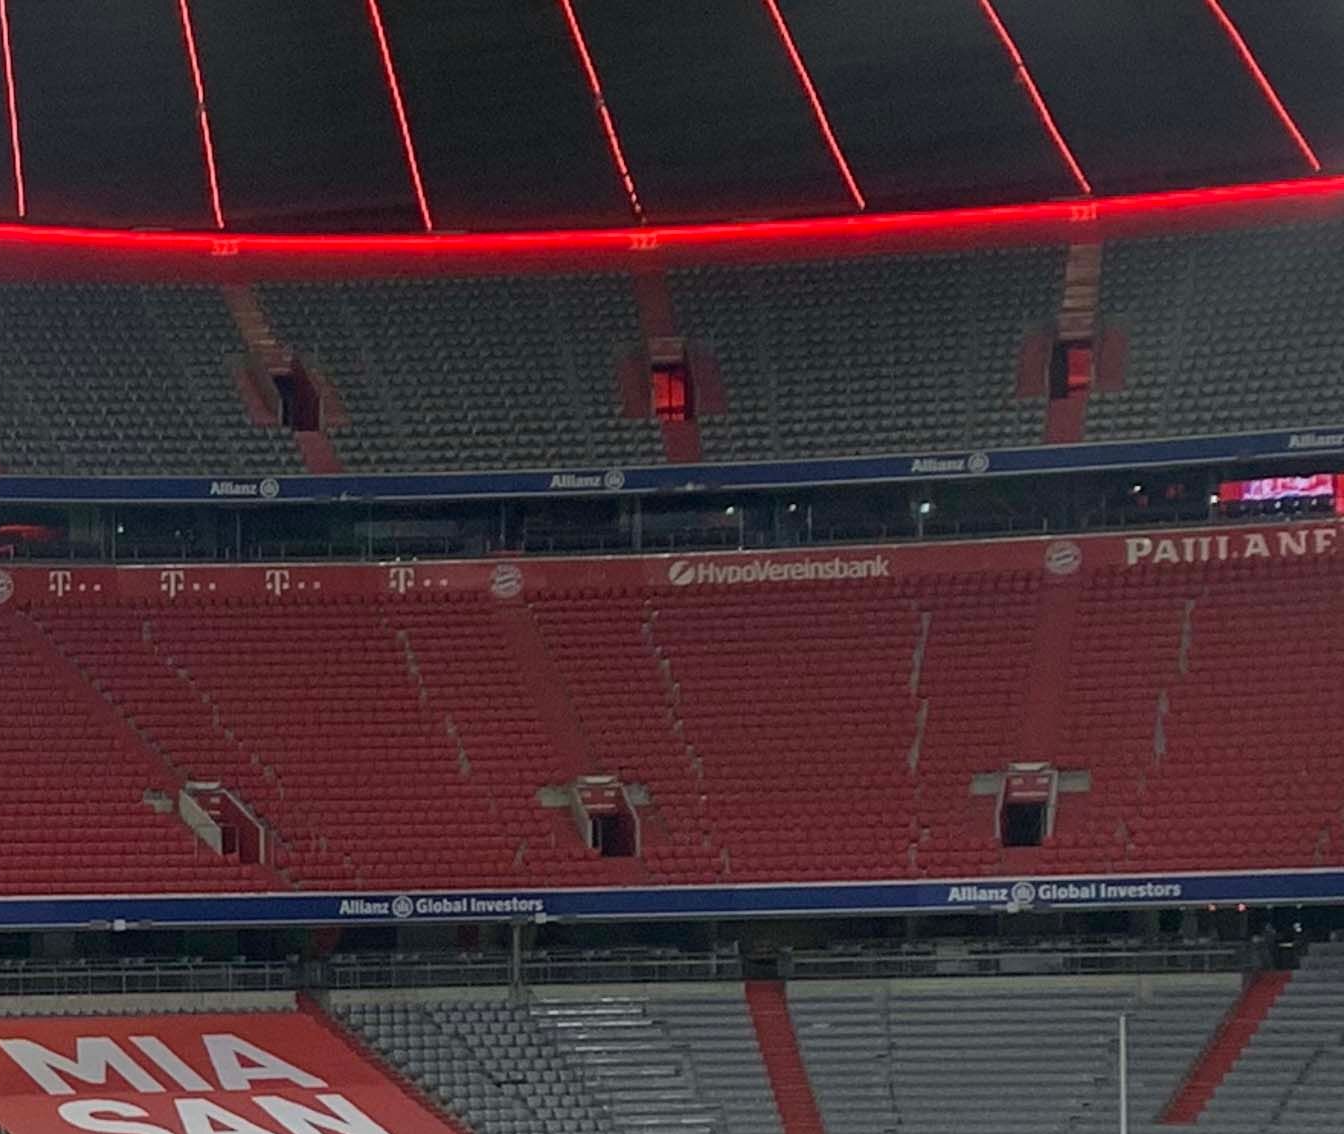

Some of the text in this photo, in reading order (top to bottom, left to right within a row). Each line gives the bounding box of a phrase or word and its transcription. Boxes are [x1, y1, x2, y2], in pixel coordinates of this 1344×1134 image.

[911, 457, 965, 473] Allianz
[210, 480, 258, 497] Allianz
[549, 472, 602, 489] Allianz
[1125, 528, 1338, 565] PAULANE
[947, 880, 1182, 902] Allianz Global Investors
[339, 896, 544, 916] Allianz Global Investors
